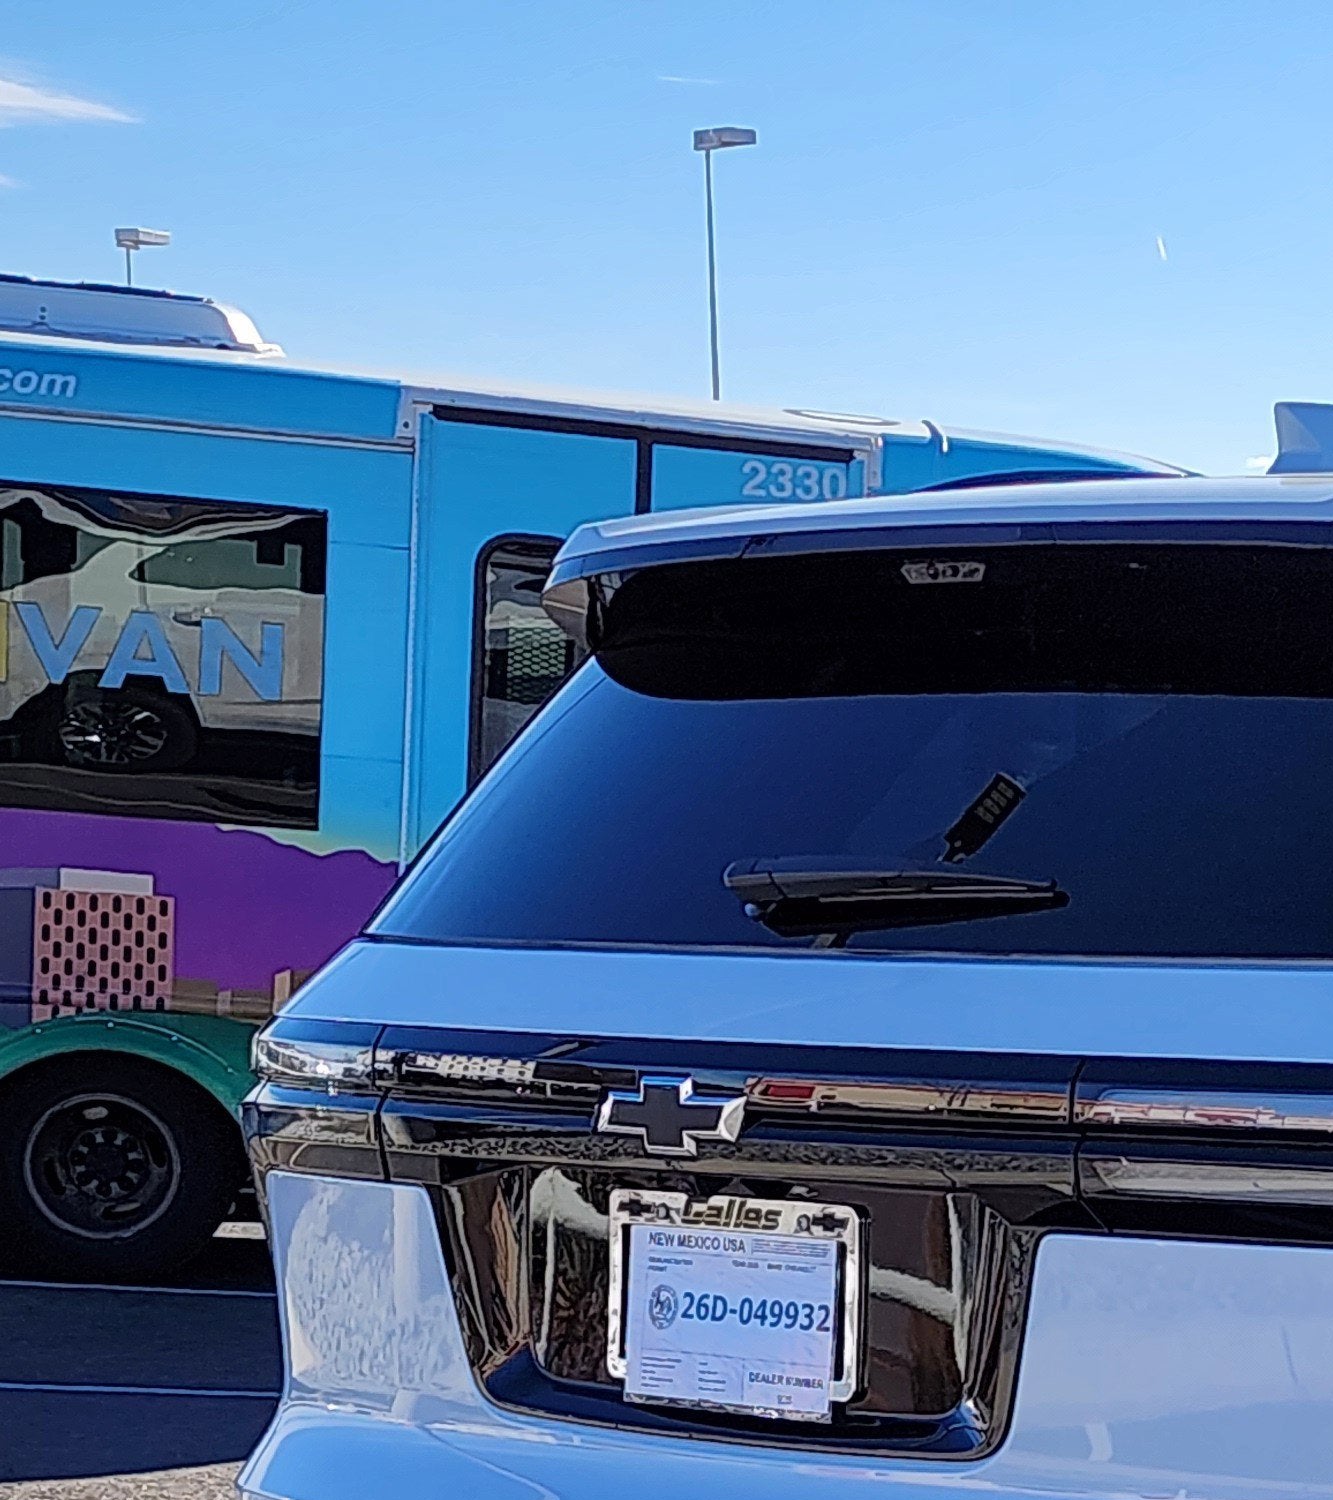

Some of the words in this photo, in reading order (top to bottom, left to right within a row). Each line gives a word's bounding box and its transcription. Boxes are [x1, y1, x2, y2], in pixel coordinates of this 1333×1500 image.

[741, 460, 848, 502] 2330
[648, 1231, 675, 1247] NEW
[676, 1233, 721, 1251] MEXICO
[723, 1237, 747, 1254] USA
[680, 1291, 831, 1333] 26D-049932
[748, 1371, 783, 1385] DEALER
